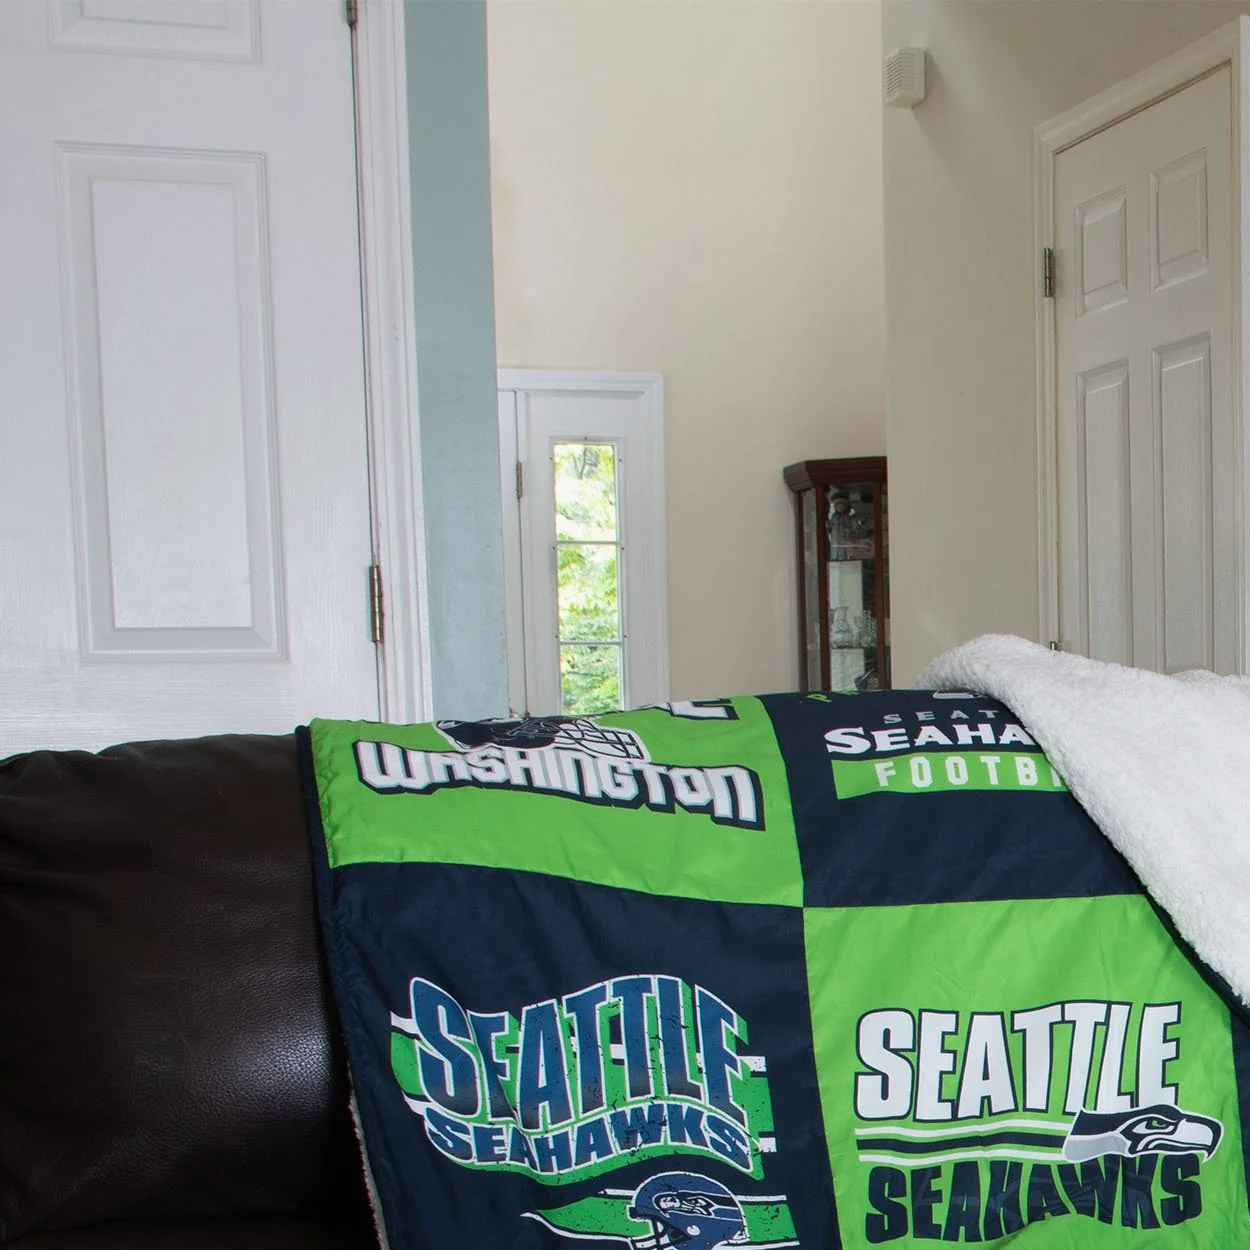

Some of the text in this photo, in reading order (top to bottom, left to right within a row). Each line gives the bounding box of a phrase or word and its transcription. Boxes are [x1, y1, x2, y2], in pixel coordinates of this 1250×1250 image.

[823, 723, 1036, 755] SEAHA
[883, 709, 998, 724] SEAT
[874, 756, 1062, 788] FOOTB
[410, 974, 750, 1132] SEATTLE
[854, 1000, 1182, 1122] SEATTLE
[424, 1102, 754, 1175] SEAHAWKS
[865, 1152, 1202, 1245] SEAHAWKS
